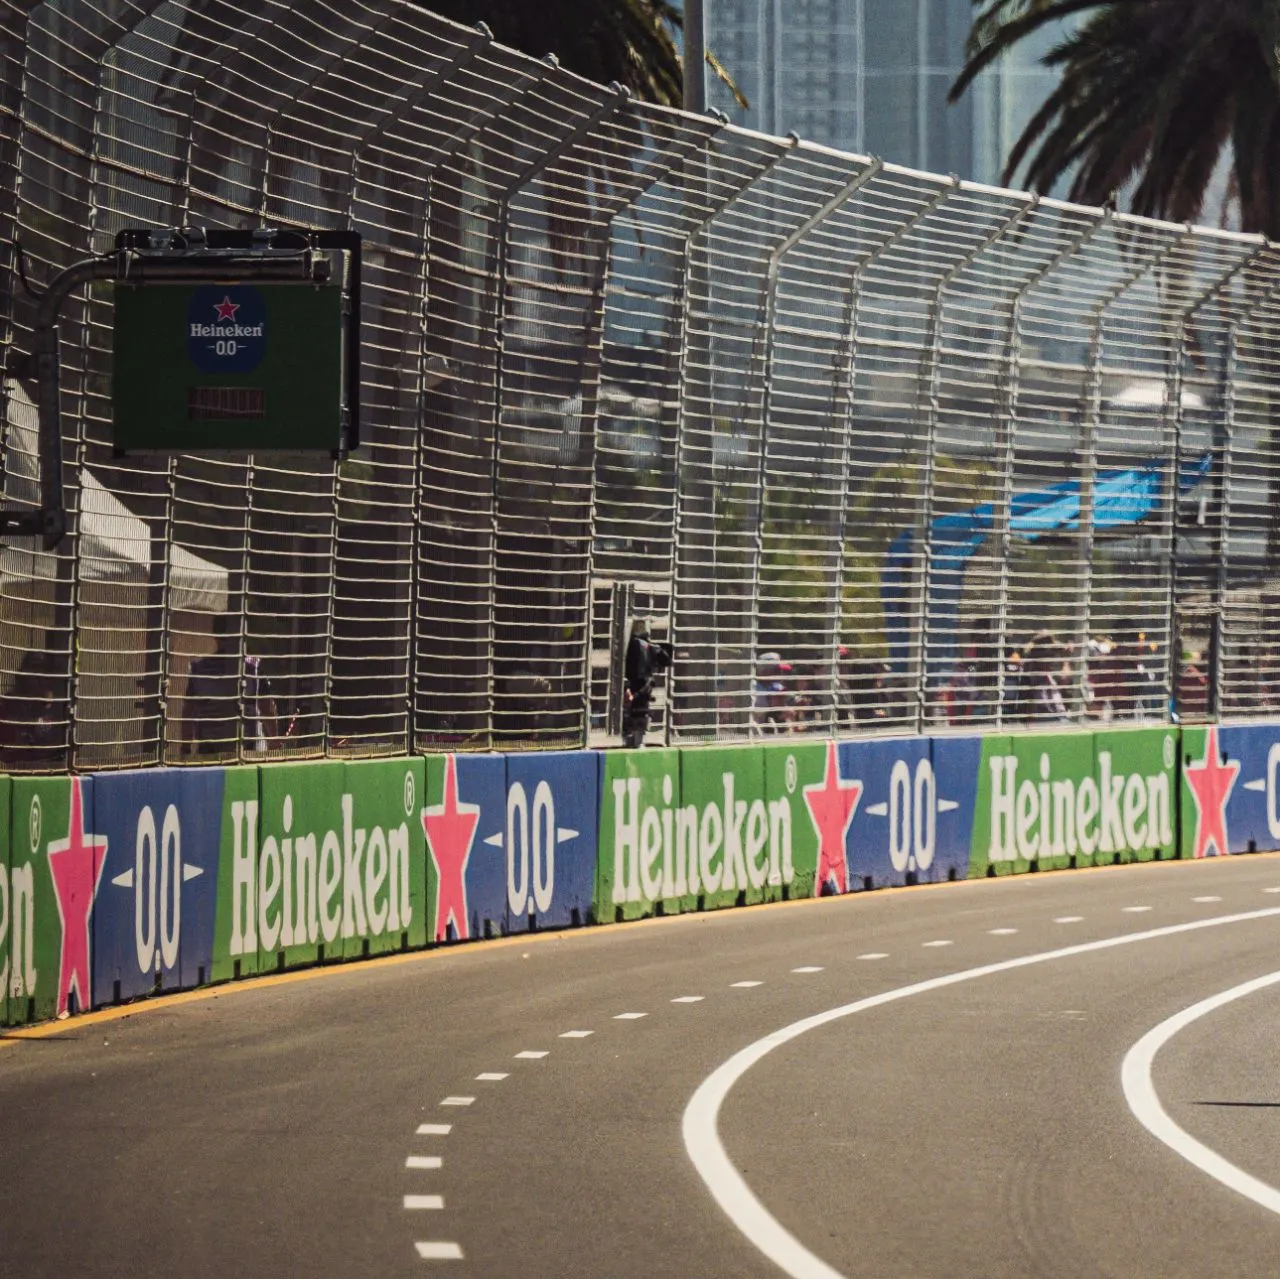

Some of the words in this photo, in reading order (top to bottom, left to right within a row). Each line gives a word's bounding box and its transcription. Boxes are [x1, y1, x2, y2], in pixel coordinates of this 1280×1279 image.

[190, 323, 262, 337] Heineken
[612, 772, 795, 903] Heineken
[989, 751, 1172, 862] Heineken
[230, 793, 411, 955] Heineken
